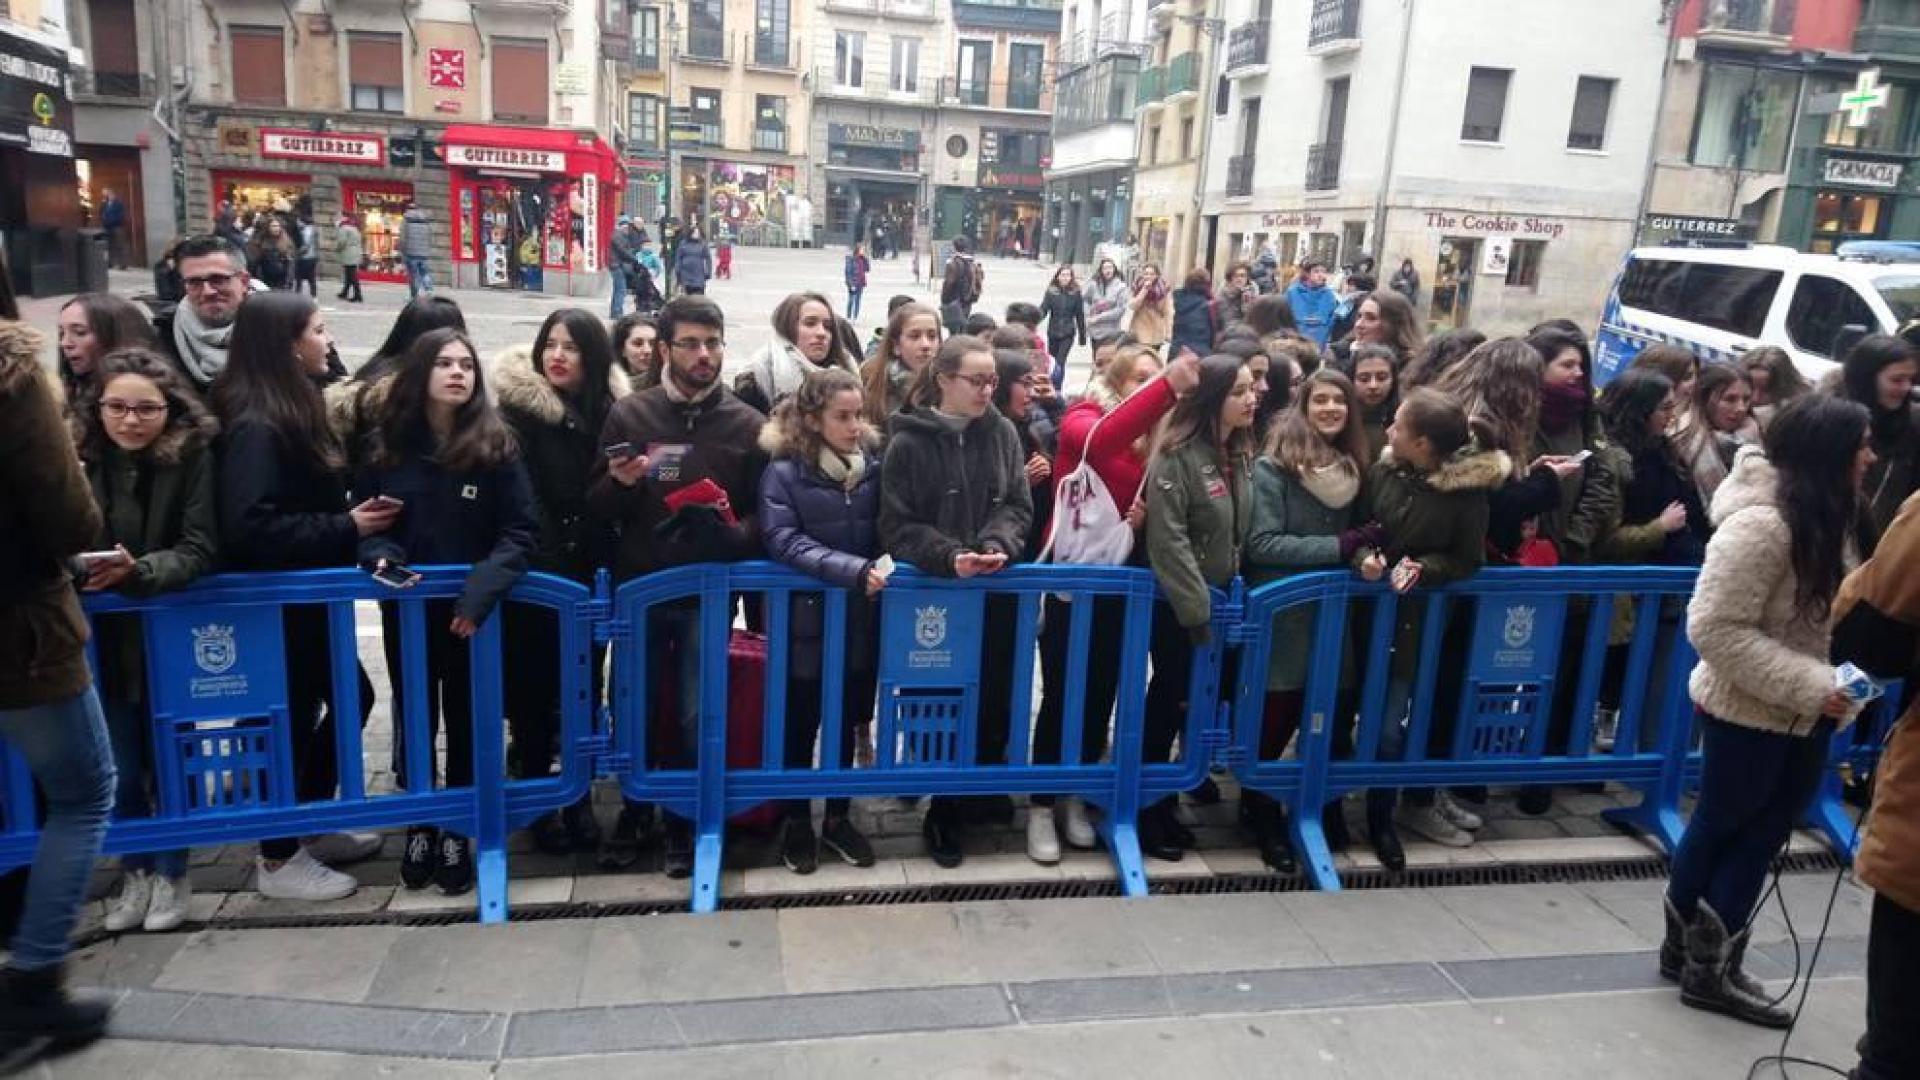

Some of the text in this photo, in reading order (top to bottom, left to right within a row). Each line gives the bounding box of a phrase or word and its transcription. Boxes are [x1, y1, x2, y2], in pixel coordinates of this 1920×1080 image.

[280, 136, 365, 156] GUTIERREZ
[463, 147, 550, 167] GUTIERREZ
[1830, 160, 1894, 183] FARMACIA
[1424, 212, 1564, 238] The Cookie Shop
[1651, 218, 1737, 234] GUTIERREZ
